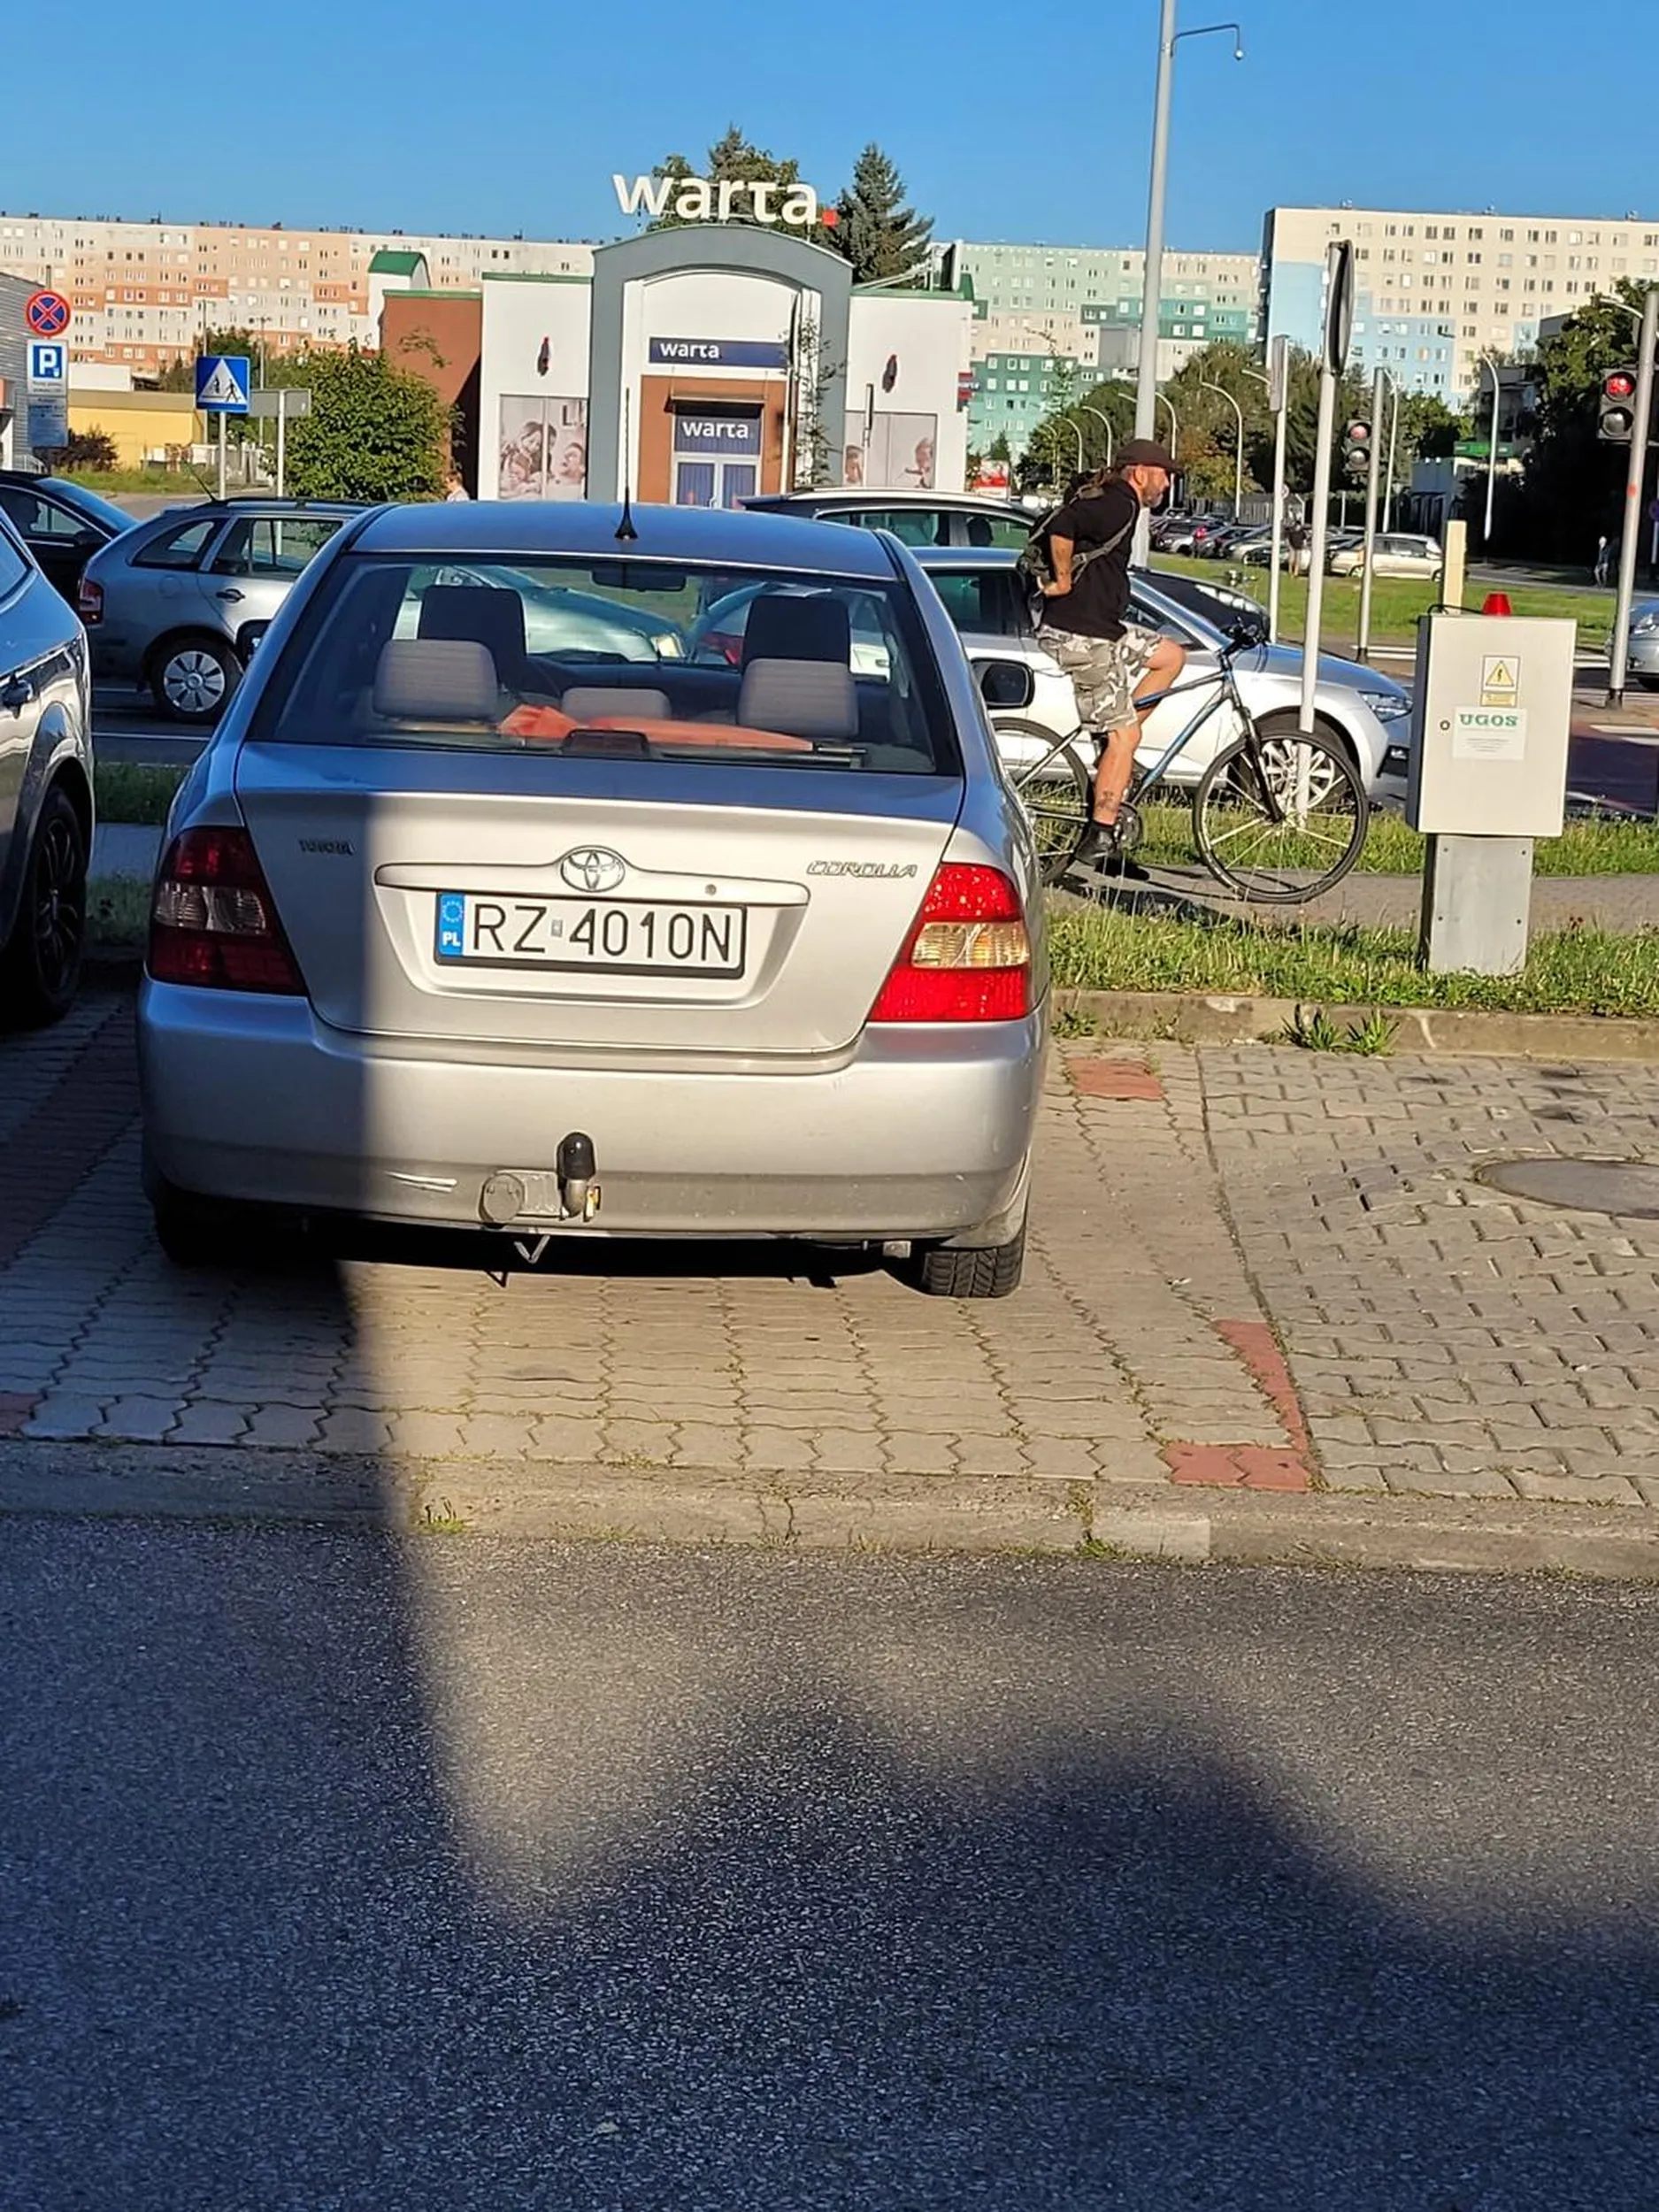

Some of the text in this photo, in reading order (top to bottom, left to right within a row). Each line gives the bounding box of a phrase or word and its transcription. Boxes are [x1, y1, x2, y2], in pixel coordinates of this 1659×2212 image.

[39, 348, 58, 376] P
[682, 421, 749, 439] warta
[1459, 713, 1518, 726] UGOS
[806, 860, 918, 878] COROLLA
[442, 902, 732, 963] PL RZ 4010N
